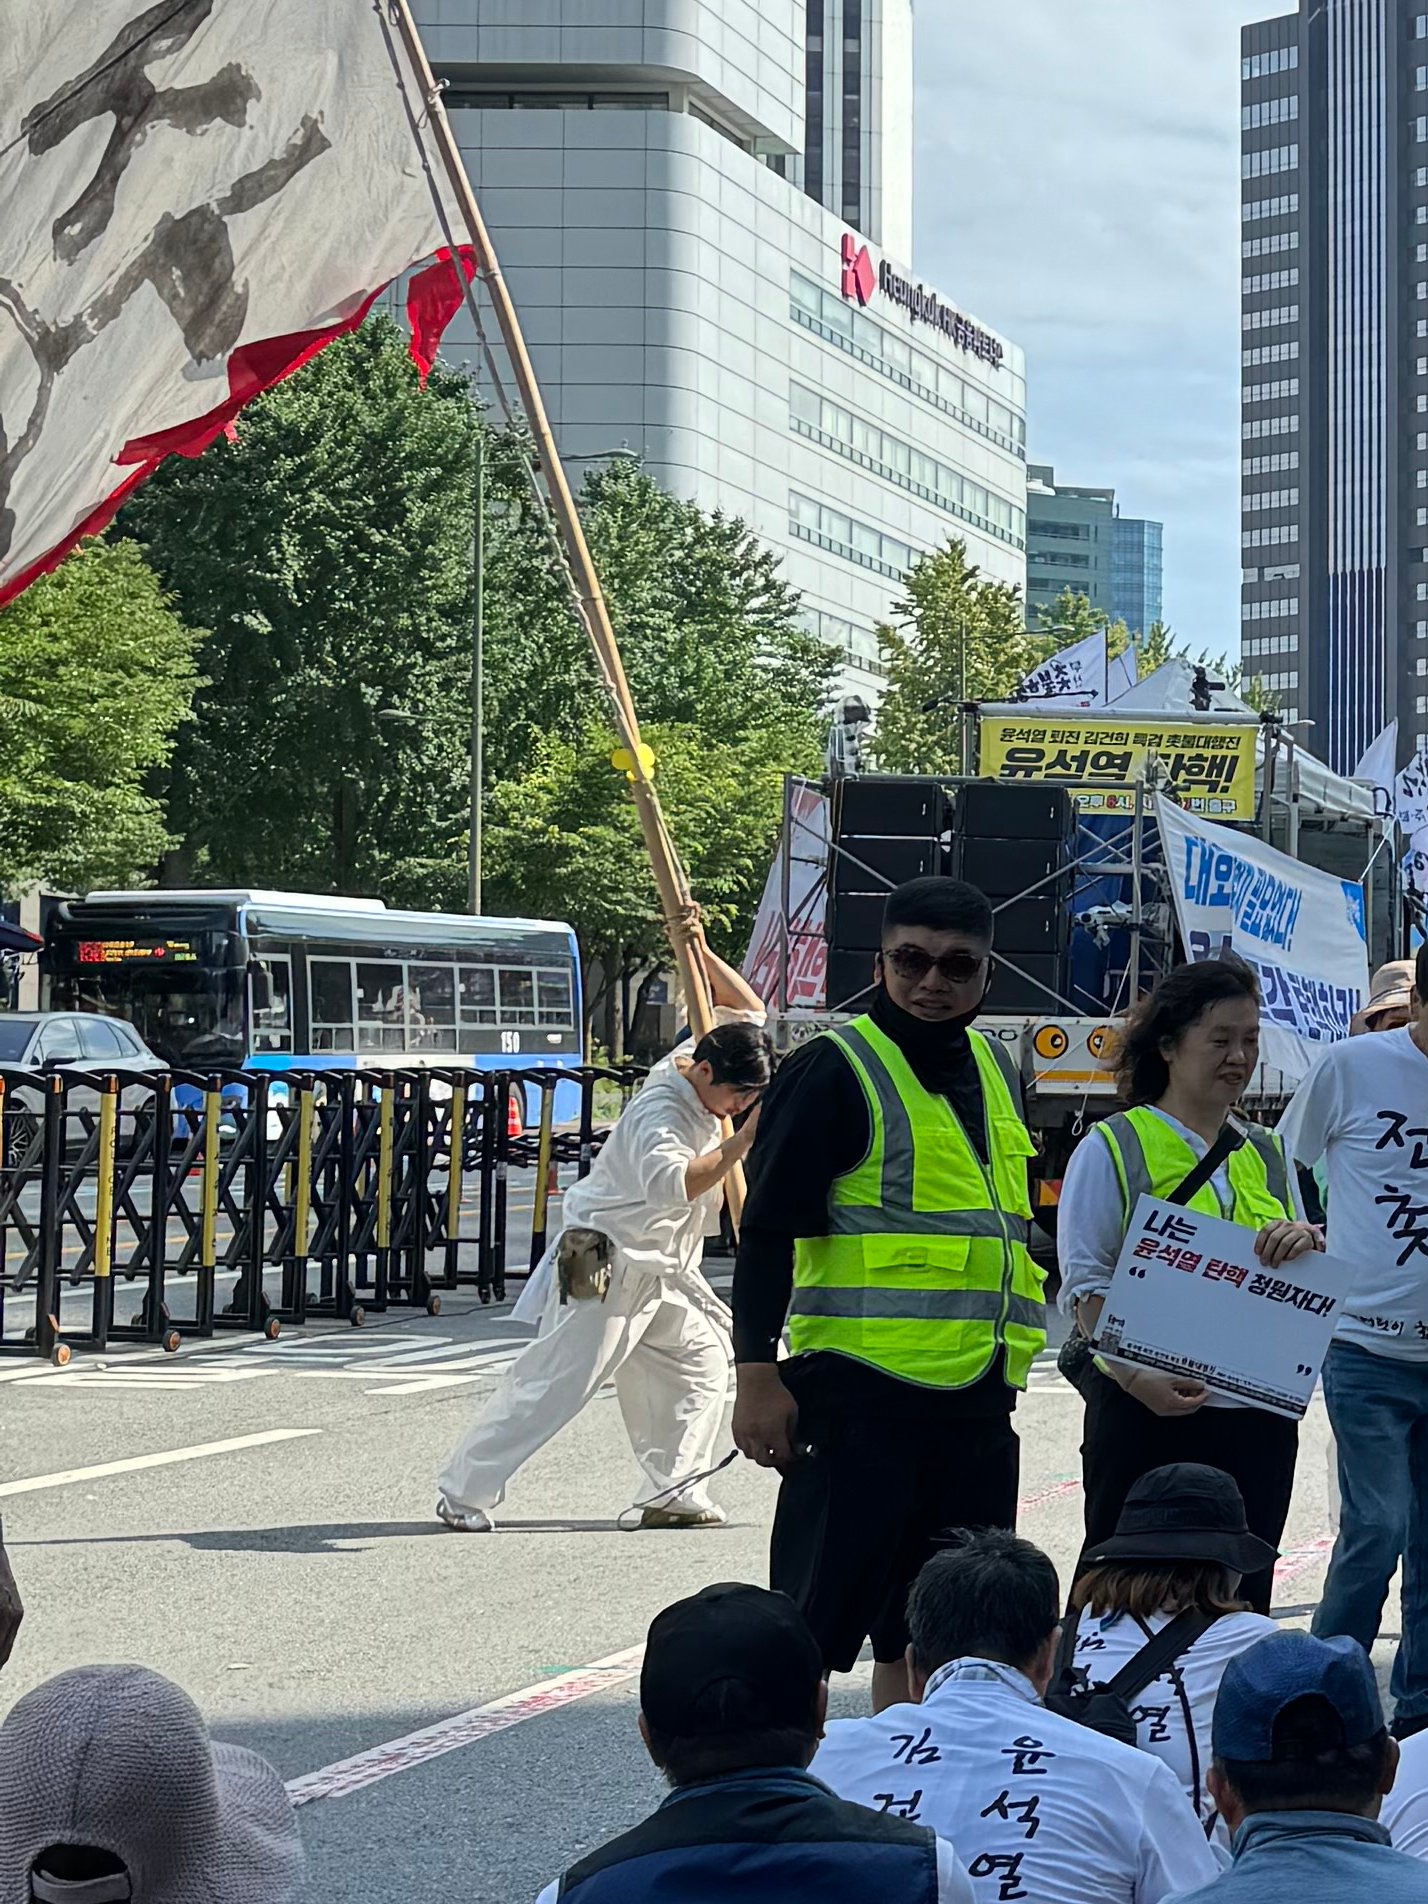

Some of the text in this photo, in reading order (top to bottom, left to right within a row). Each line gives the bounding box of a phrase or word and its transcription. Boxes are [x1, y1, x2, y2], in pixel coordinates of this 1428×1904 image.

[1000, 728, 1047, 743] 윤석열
[1085, 731, 1130, 746] 김건희
[1166, 734, 1241, 750] 촛불대행진
[501, 1031, 520, 1053] 150
[1143, 1210, 1197, 1244] 나는
[1133, 1237, 1336, 1317] 윤석열 탄핵 청원자다!
